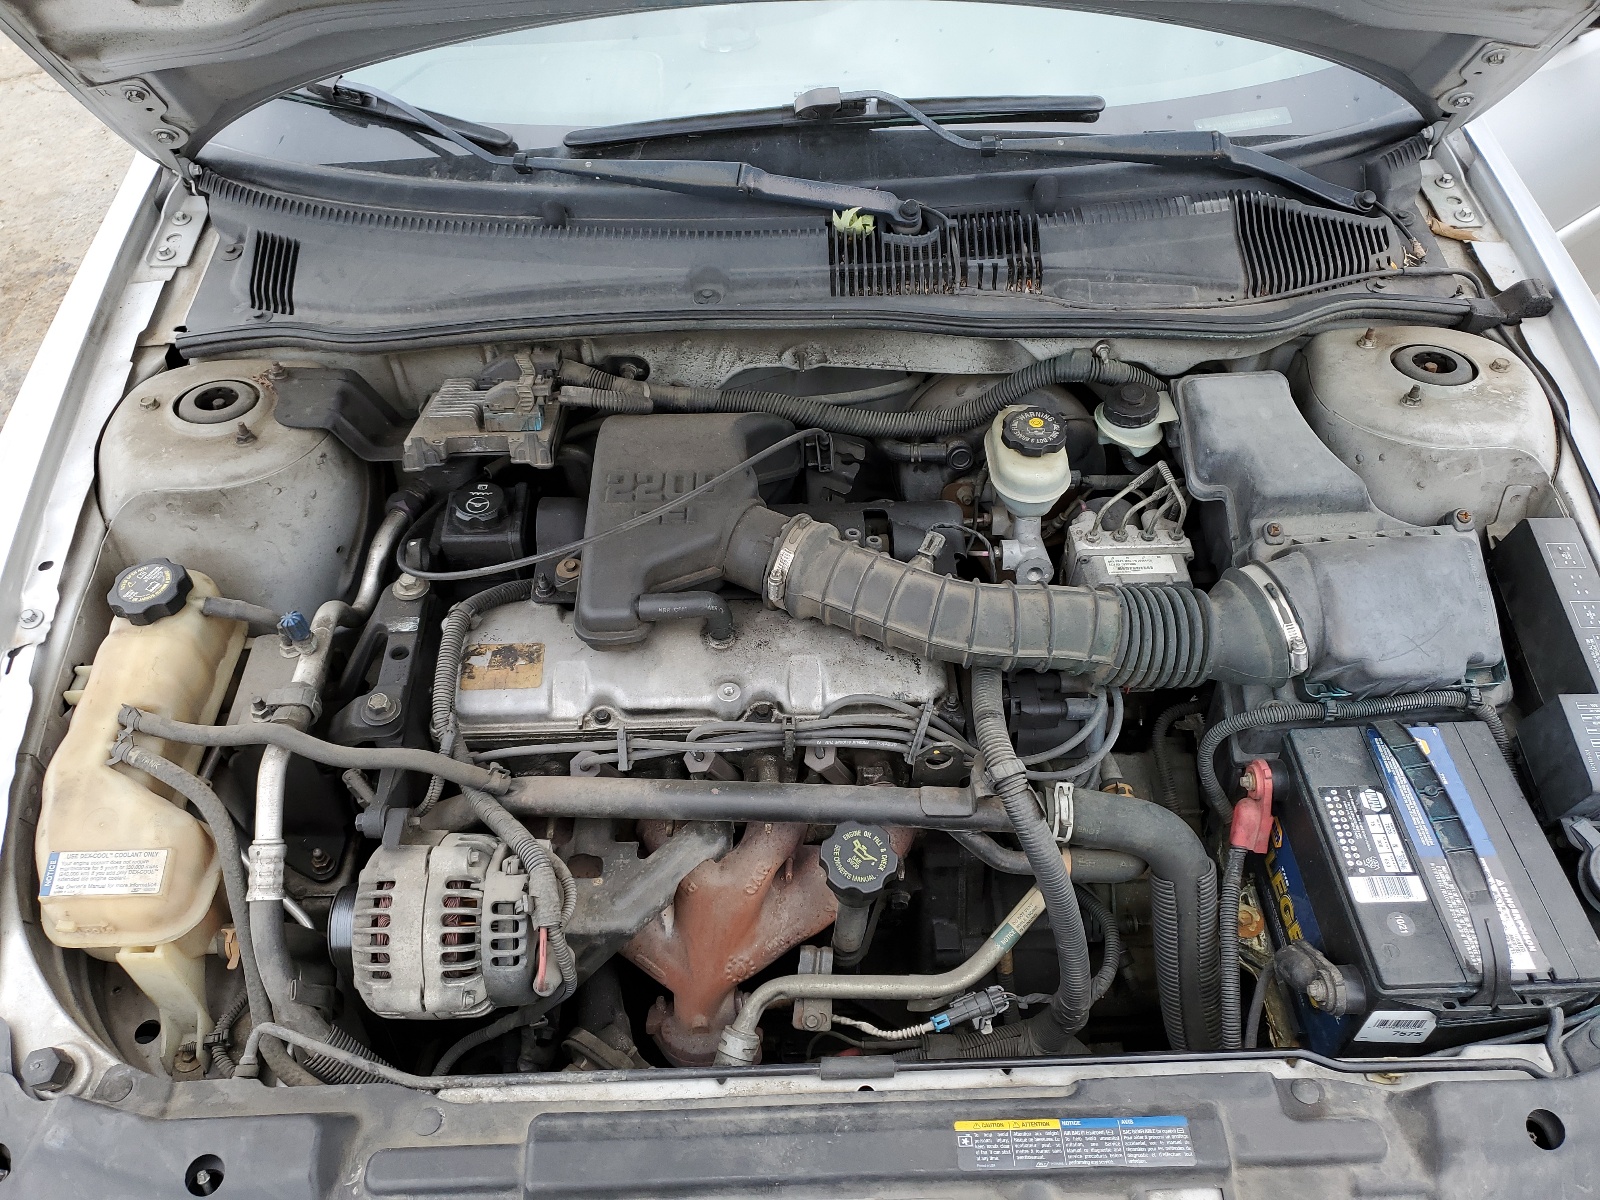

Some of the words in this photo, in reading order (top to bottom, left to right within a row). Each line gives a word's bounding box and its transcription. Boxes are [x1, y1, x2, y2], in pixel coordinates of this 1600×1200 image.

[1018, 411, 1055, 422] WARNING
[842, 829, 862, 841] ENGINE
[863, 830, 872, 839] OIL
[873, 835, 883, 849] FILL
[833, 844, 842, 856] SEE
[833, 856, 853, 879] OWNER'S
[877, 854, 888, 872] CHECK
[44, 860, 57, 887] NOTICE
[851, 874, 877, 883] MANUAL
[1395, 915, 1409, 933] 10/21
[1001, 928, 1017, 945] NOTICE
